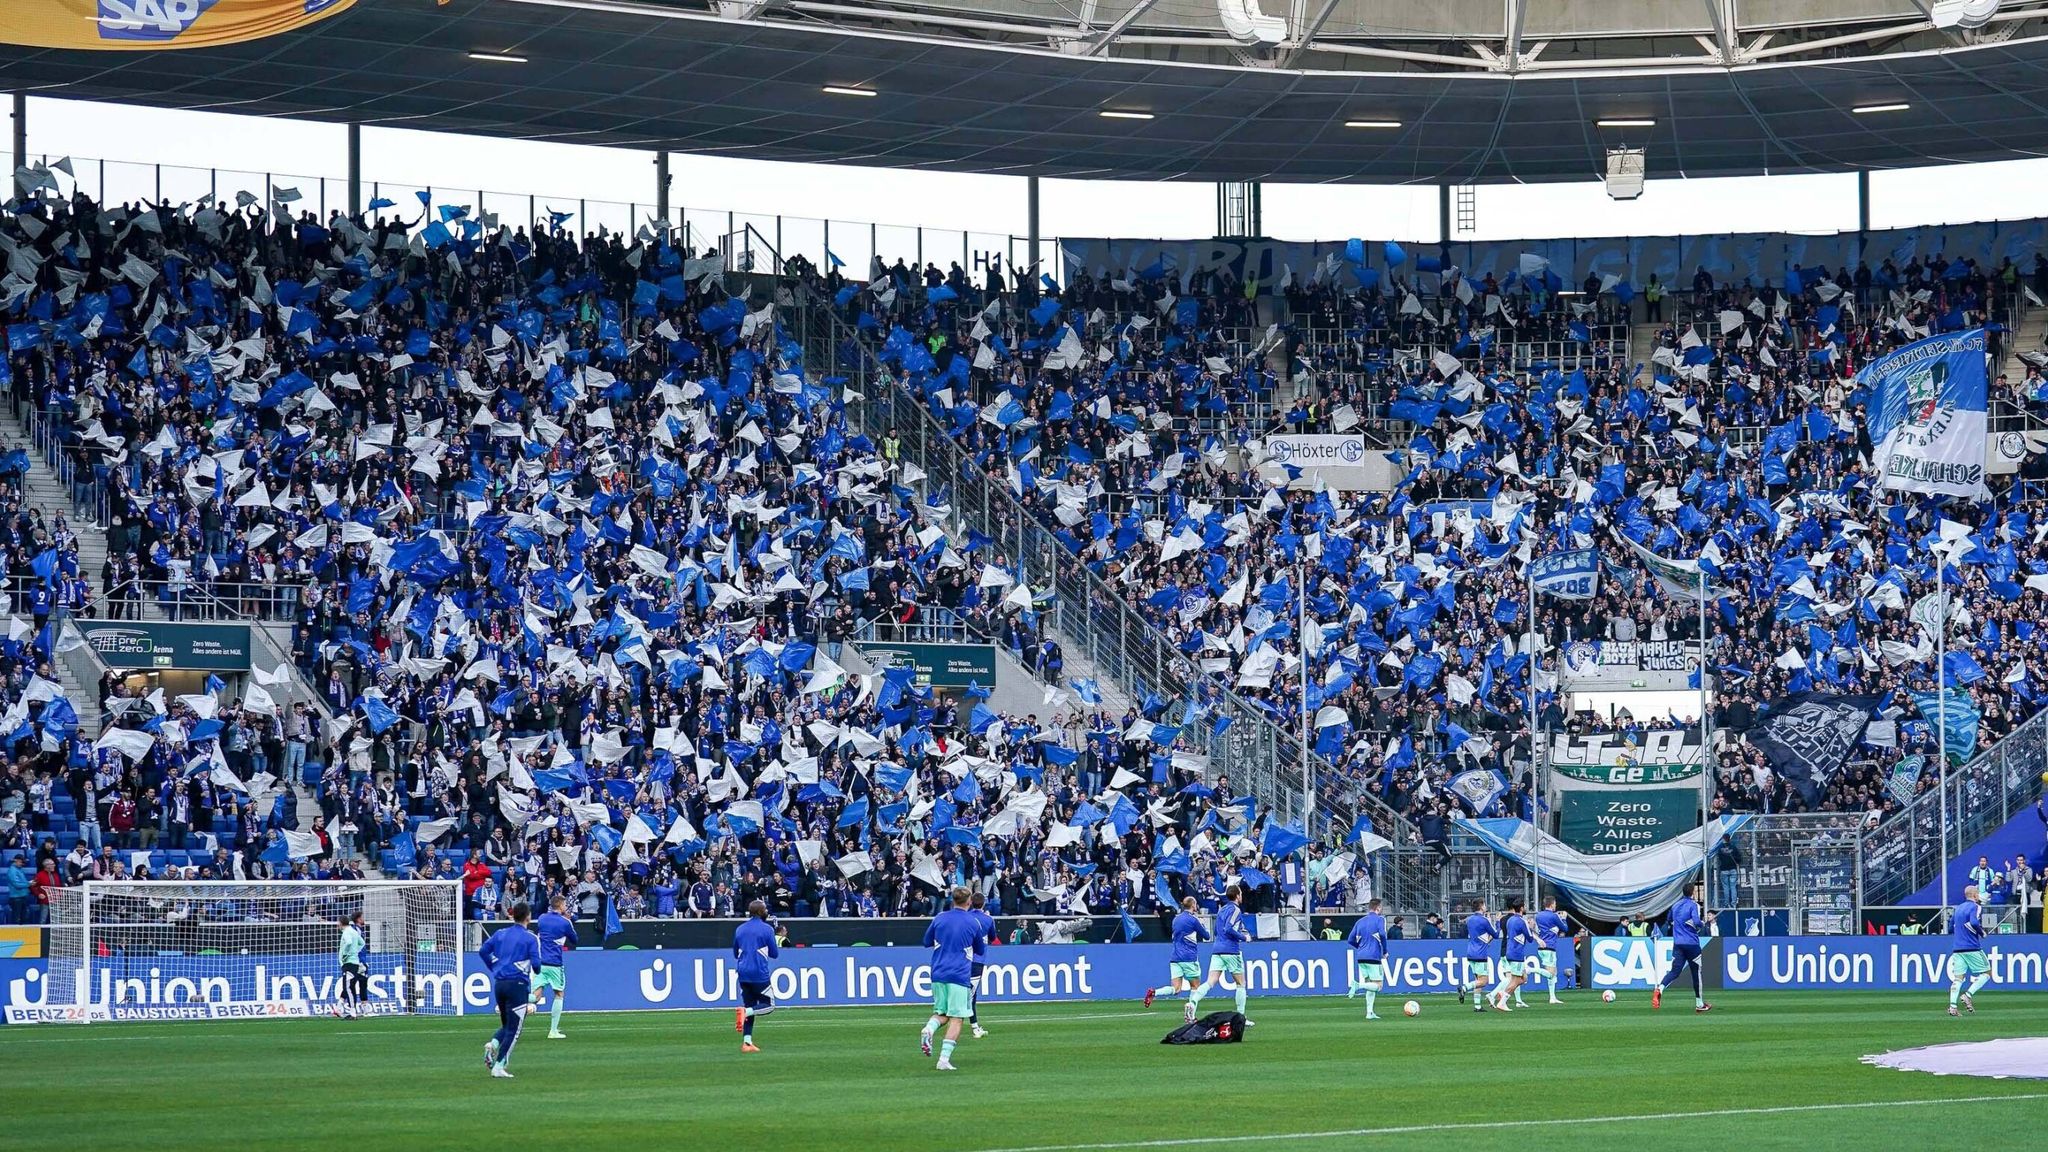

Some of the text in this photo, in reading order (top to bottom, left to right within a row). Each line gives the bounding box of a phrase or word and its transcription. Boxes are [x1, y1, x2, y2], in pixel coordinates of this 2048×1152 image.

[974, 249, 1001, 272] H1
[1291, 443, 1340, 458] Höxter
[119, 637, 137, 646] pre
[119, 645, 174, 654] zero Arena
[1638, 640, 1685, 656] MARLER
[1643, 656, 1685, 670] JUNGS
[916, 665, 933, 673] Arena
[1608, 802, 1652, 812] Zero
[1597, 815, 1663, 826] Waste.
[1604, 829, 1653, 839] Alles
[1771, 944, 1873, 984] Union
